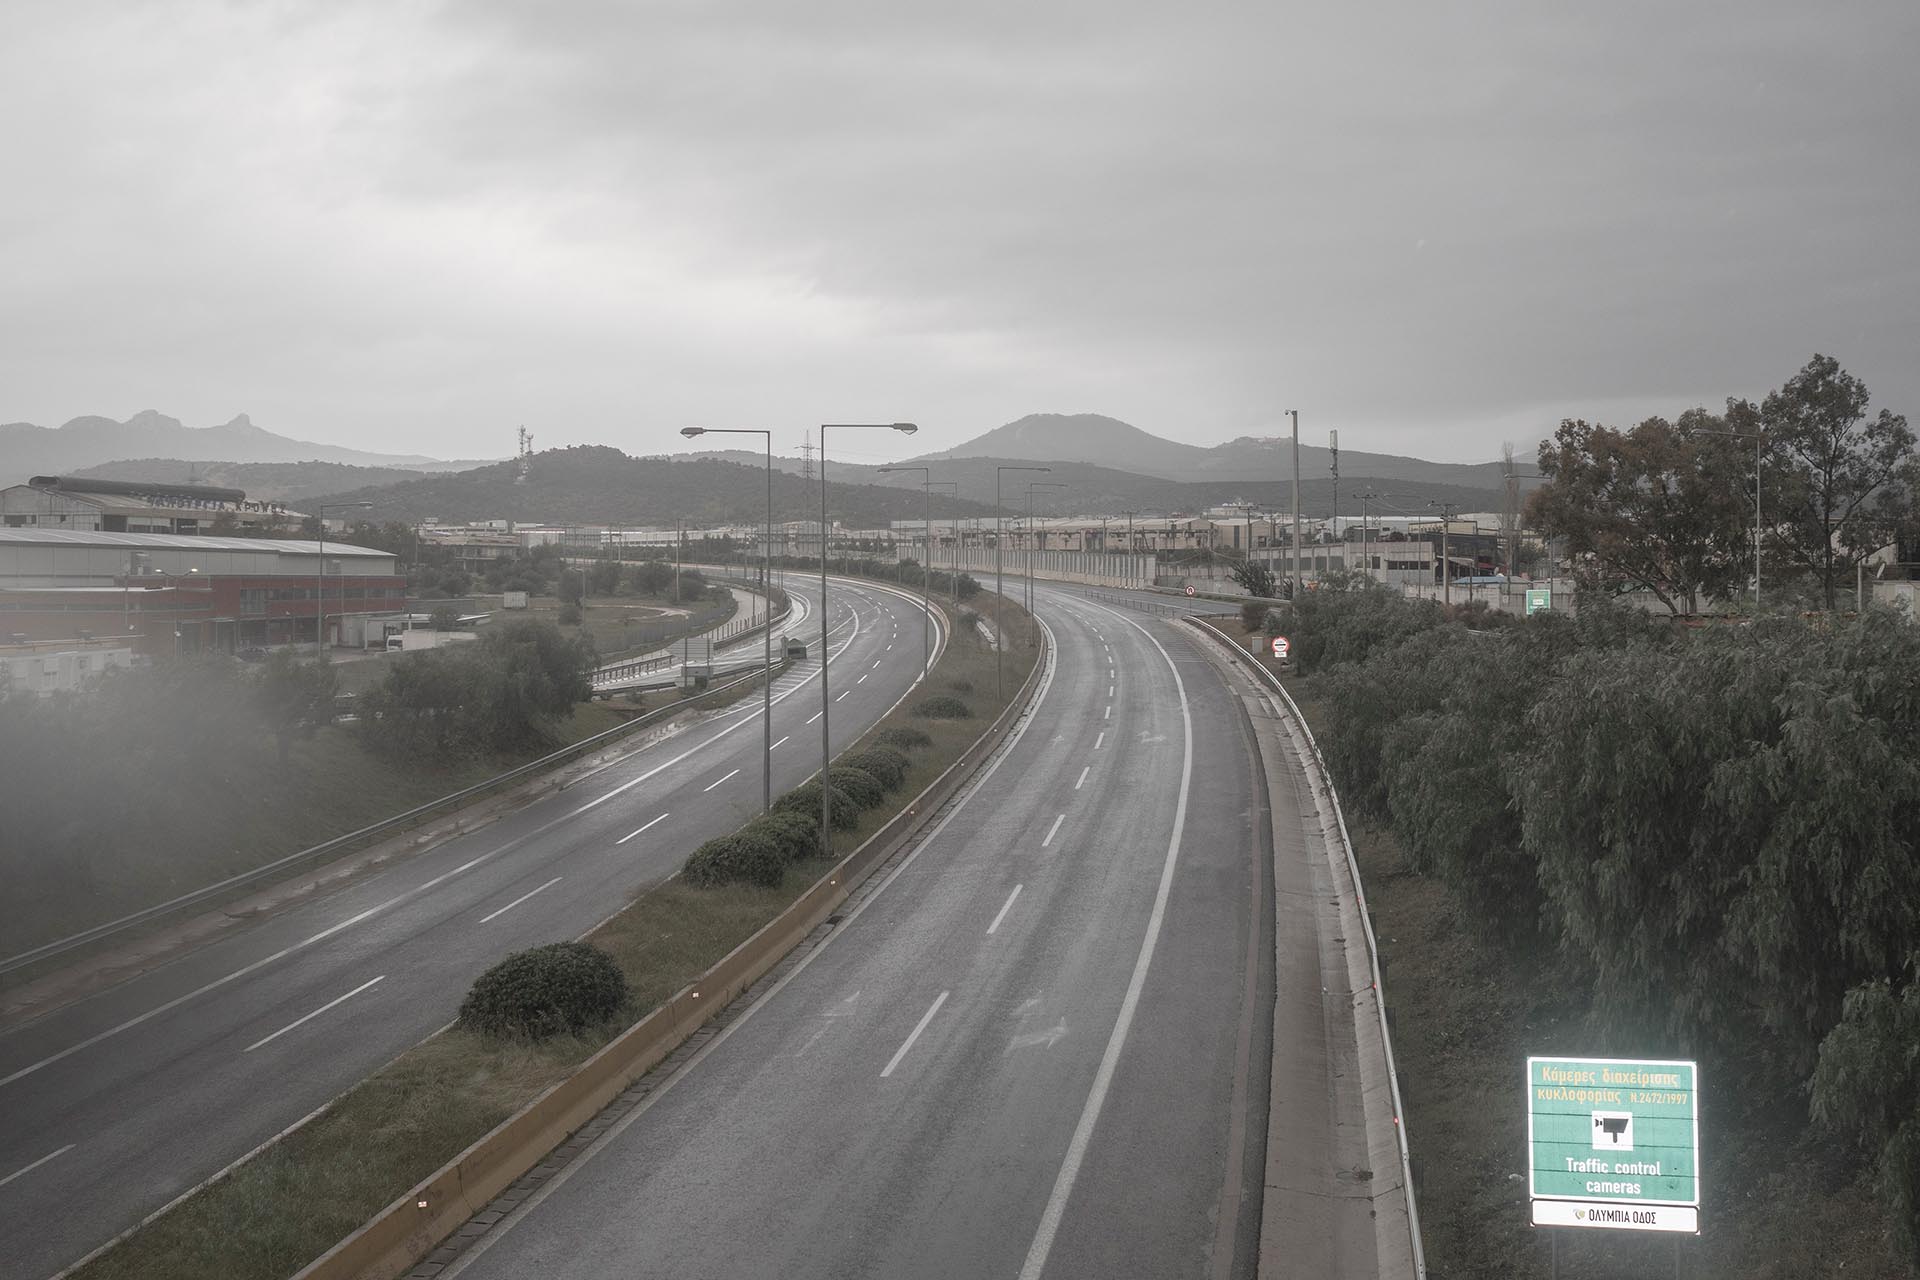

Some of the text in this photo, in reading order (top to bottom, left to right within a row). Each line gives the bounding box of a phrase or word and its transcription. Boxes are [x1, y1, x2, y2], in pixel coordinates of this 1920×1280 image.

[1542, 1066, 1679, 1087] Κάμερες διαχείρισης
[1537, 1087, 1621, 1104] κυκλοφορίας
[1565, 1157, 1661, 1176] Traffic control
[1586, 1180, 1641, 1195] cameras
[1588, 1208, 1656, 1224] ΟΛΥΜΠΙΑ ΟΔΟΣ
